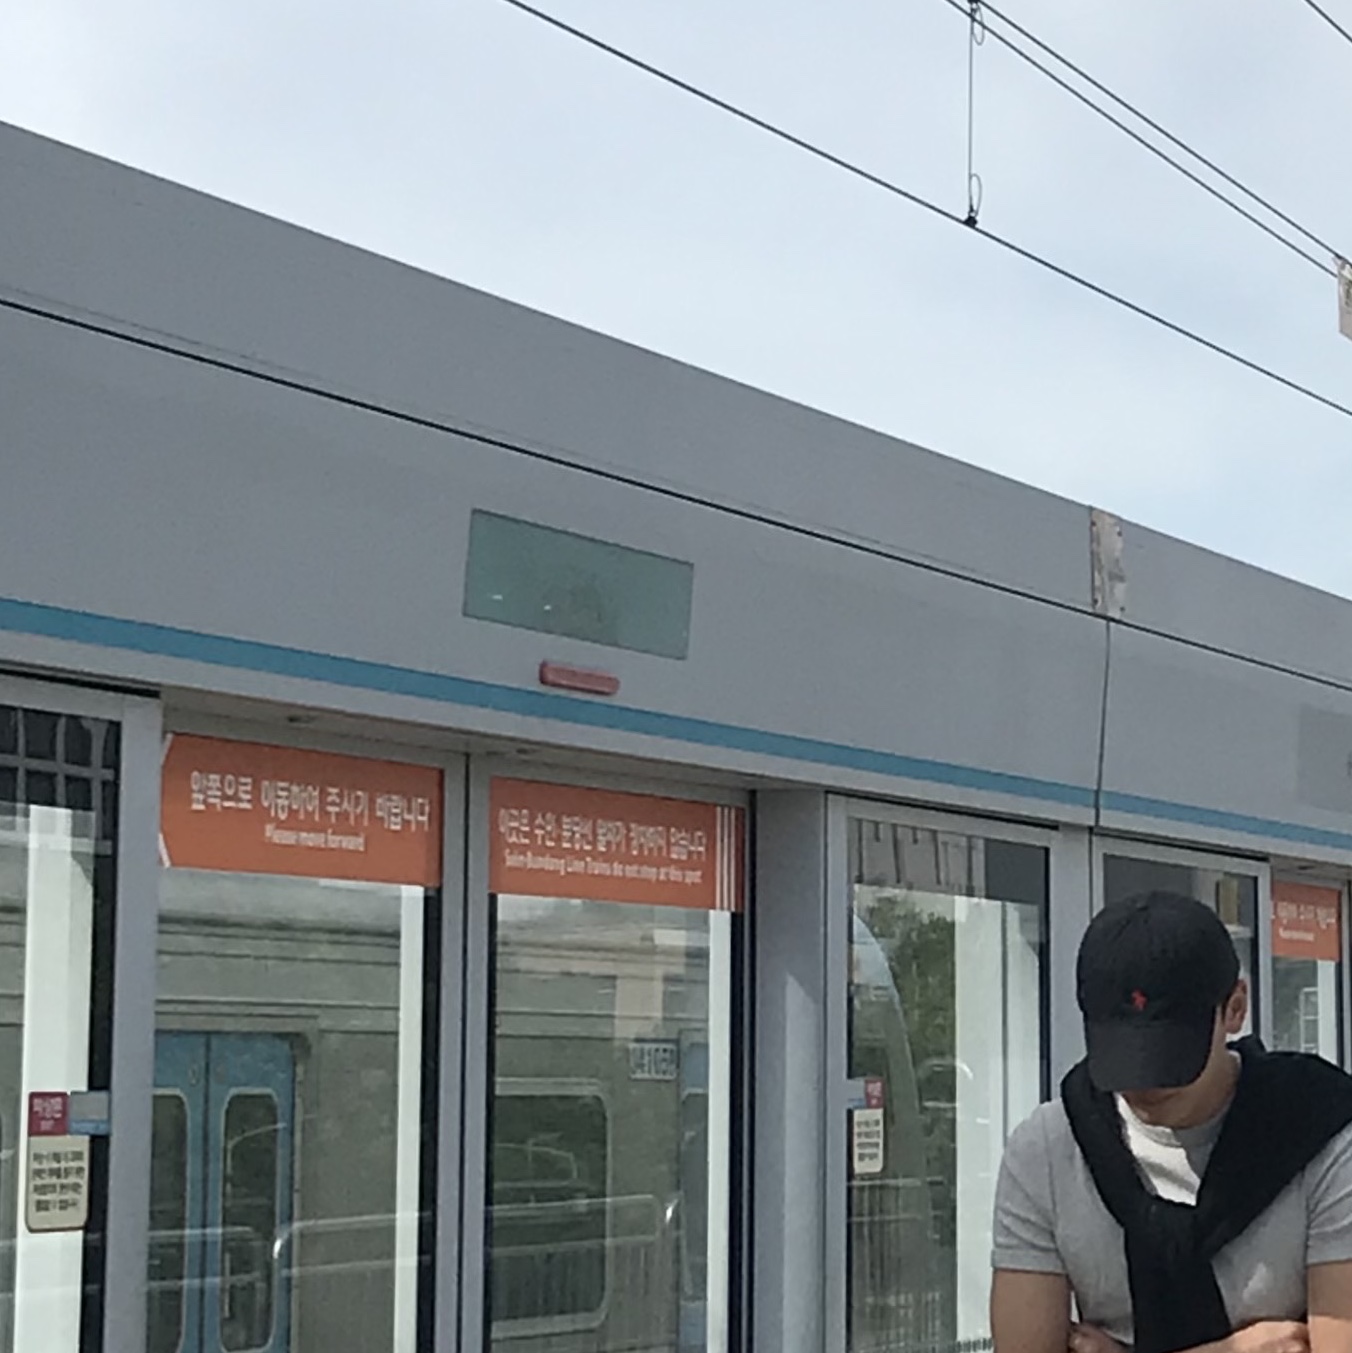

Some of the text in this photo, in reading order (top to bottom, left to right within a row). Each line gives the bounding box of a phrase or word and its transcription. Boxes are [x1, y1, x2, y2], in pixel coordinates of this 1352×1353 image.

[190, 770, 431, 832] 앞쪽으로 이동하여 주시기 바랍니다
